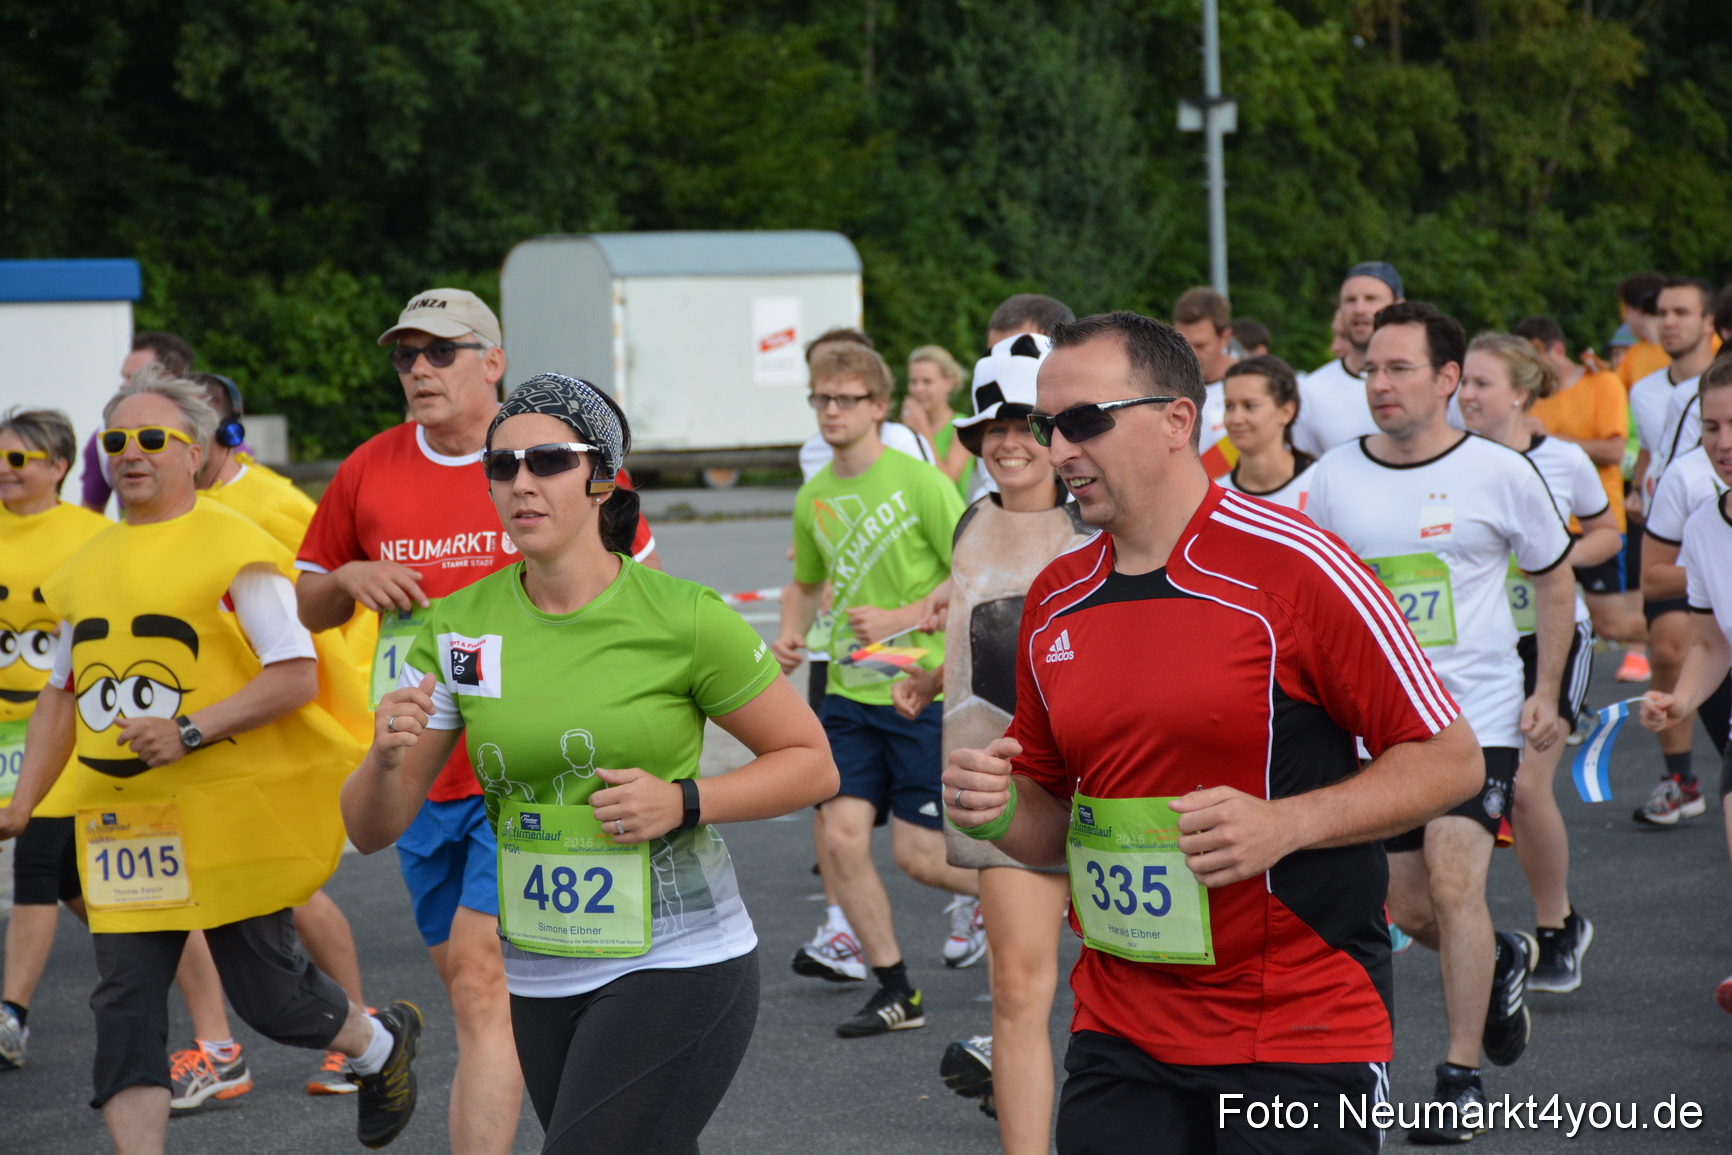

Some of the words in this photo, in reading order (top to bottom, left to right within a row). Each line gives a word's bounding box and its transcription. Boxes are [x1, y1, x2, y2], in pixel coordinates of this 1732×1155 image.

[380, 531, 496, 561] NEUMARKT
[441, 560, 468, 569] STARKE
[470, 559, 494, 567] STADT
[1512, 585, 1530, 609] 3
[1046, 650, 1075, 663] adidas
[513, 826, 562, 841] firmenlauf
[1074, 820, 1112, 838] firmenlauf
[563, 837, 594, 848] 2016
[1115, 833, 1145, 845] 2016
[95, 845, 179, 882] 1015
[523, 864, 615, 914] 482
[1086, 860, 1172, 917] 335
[538, 922, 568, 935] Simone
[570, 926, 602, 935] Eibner
[1108, 924, 1129, 937] Harald
[1130, 929, 1161, 939] Eibner
